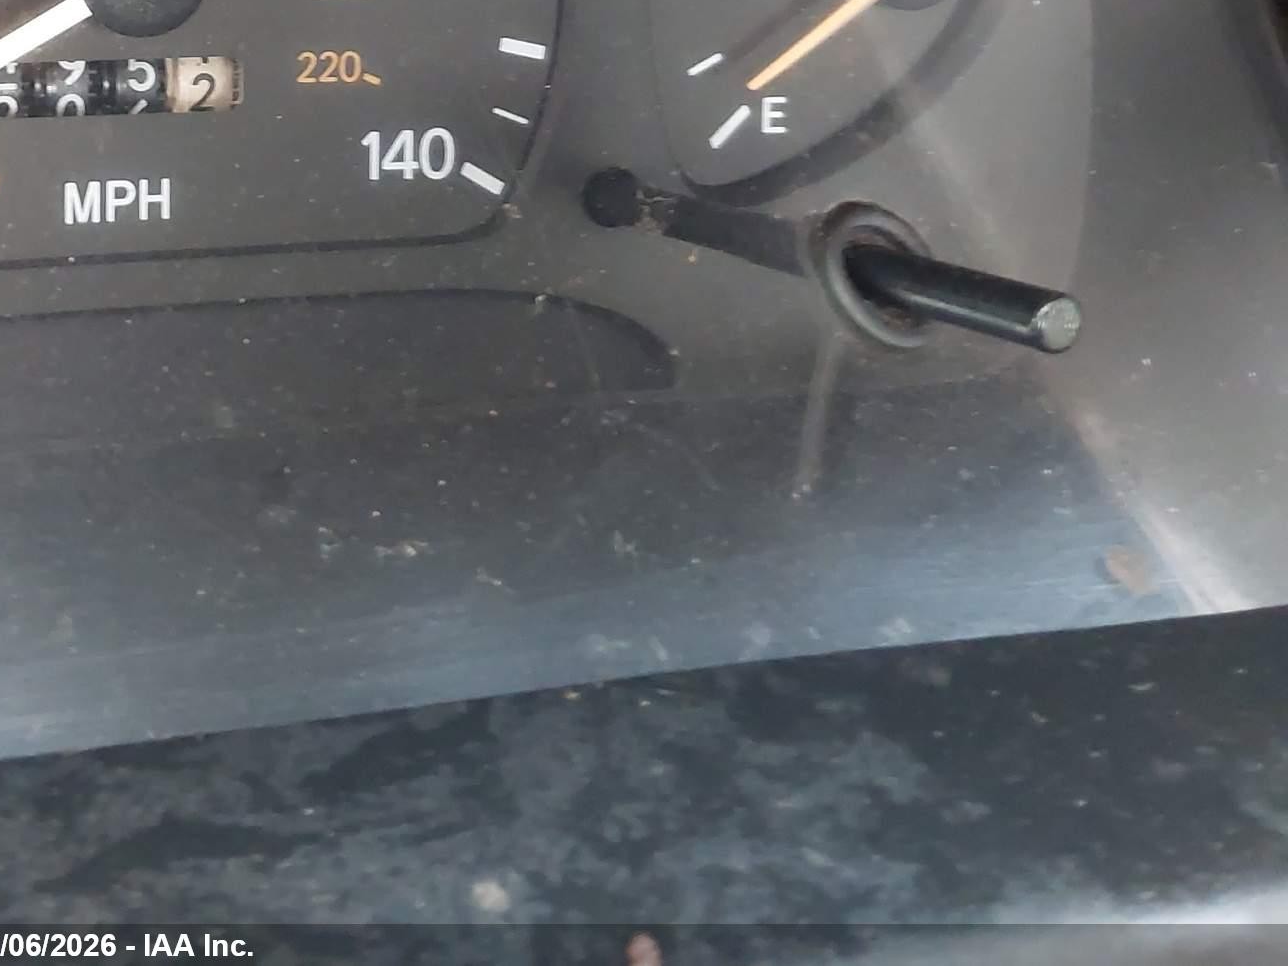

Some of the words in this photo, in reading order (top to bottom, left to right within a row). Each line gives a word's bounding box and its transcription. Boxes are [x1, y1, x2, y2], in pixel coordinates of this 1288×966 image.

[297, 51, 362, 83] 220
[762, 97, 787, 133] E
[362, 128, 455, 180] 140
[65, 179, 170, 224] MPH
